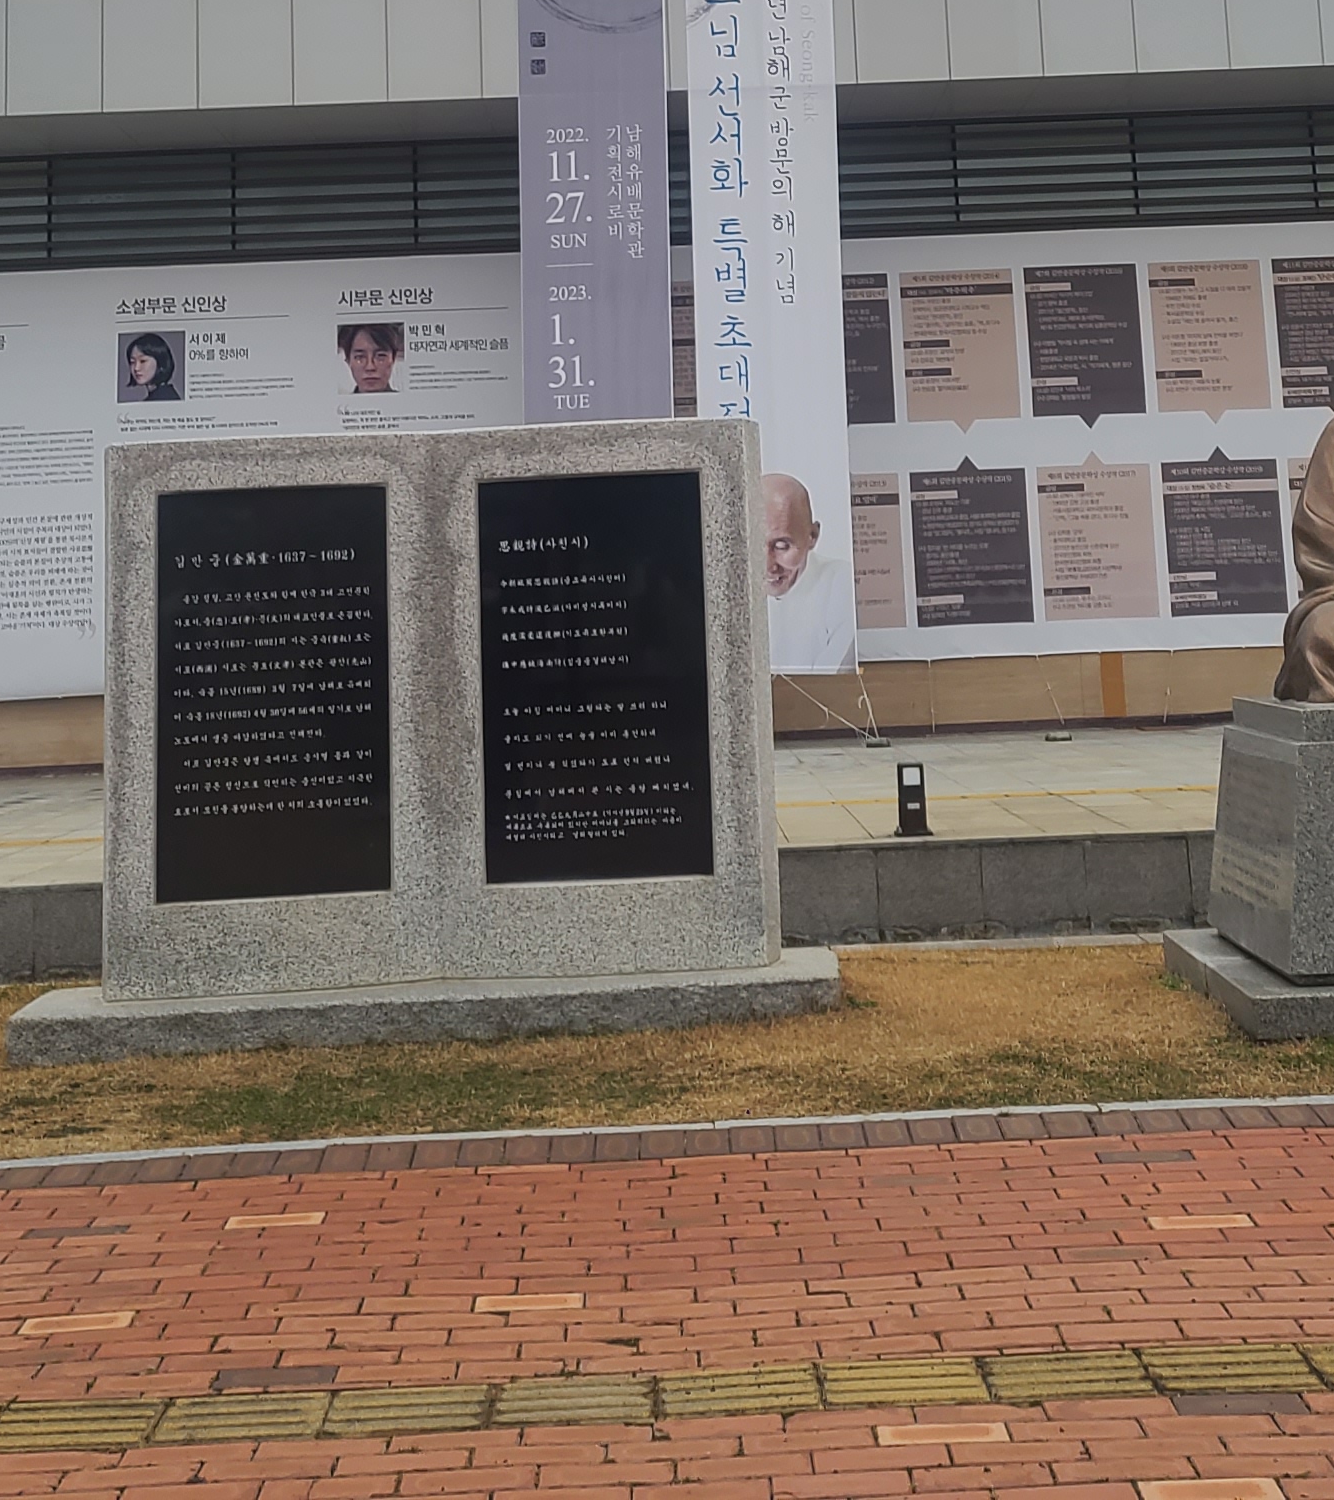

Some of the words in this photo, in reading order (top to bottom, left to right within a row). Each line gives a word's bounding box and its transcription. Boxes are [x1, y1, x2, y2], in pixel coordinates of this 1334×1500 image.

[800, 4, 816, 23] of
[799, 30, 819, 122] Seong-kak
[546, 127, 589, 144] 2022.
[708, 72, 749, 198] 선서화
[548, 150, 590, 182] 11.
[625, 124, 645, 259] 남해유배문학관
[545, 191, 593, 224] 27.
[771, 210, 795, 238] 해
[550, 233, 587, 249] SUN
[713, 218, 749, 303] 특별
[775, 247, 795, 304] 기념
[115, 297, 177, 315] 소설부문
[181, 295, 227, 313] 신인상
[338, 289, 384, 308] 시부문
[388, 287, 434, 305] 신인상
[548, 285, 592, 301] 2023.
[550, 313, 576, 345] 1.
[218, 348, 249, 361] 향하여
[409, 340, 448, 353] 대자연과
[449, 338, 488, 352] 세계적인
[548, 355, 595, 389] 31.
[553, 393, 590, 410] TUE
